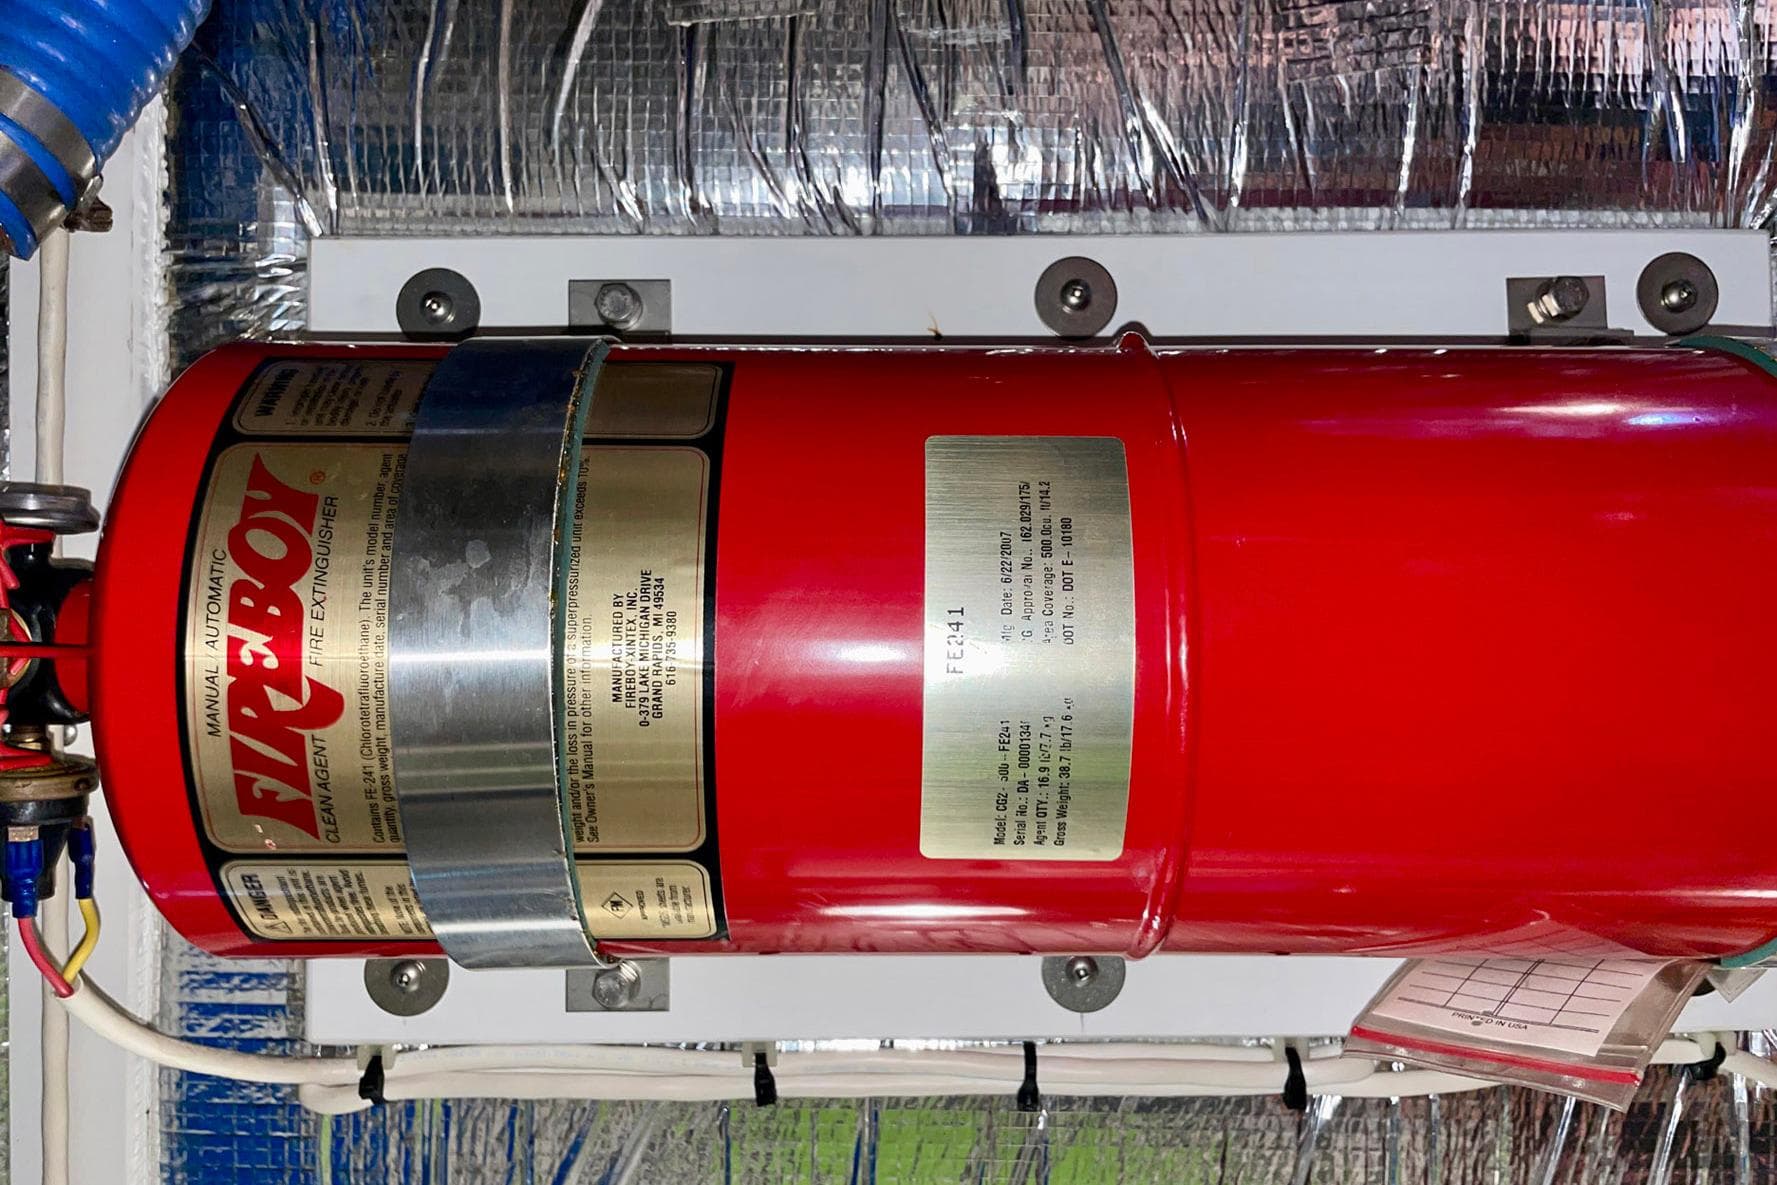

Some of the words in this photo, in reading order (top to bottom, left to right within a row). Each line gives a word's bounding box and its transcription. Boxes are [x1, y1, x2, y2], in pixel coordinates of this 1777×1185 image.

[255, 368, 299, 417] WARNING
[379, 453, 393, 479] agent
[387, 496, 398, 506] of
[573, 481, 587, 520] exceeds
[384, 507, 397, 530] area
[571, 523, 583, 542] unit
[365, 523, 379, 556] model
[380, 532, 393, 551] and
[311, 495, 338, 621] EXTINGUISHER
[1000, 531, 1012, 584] 6/22/2007
[362, 559, 375, 588] unit's
[377, 553, 390, 596] number
[640, 569, 652, 603] DRIVE
[1041, 562, 1056, 616] Coverage:
[1061, 570, 1074, 592] DOT
[205, 548, 226, 651] AUTOMATIC
[358, 591, 372, 611] The
[566, 545, 581, 640] superpressurized
[612, 593, 624, 608] BY
[626, 587, 638, 610] INC.
[653, 577, 665, 610] 49534
[1000, 588, 1013, 615] Date:
[1062, 596, 1074, 619] No.:
[374, 598, 386, 628] serial
[653, 613, 664, 627] MI
[226, 453, 344, 840] FIREBOY
[309, 626, 325, 667] FIRE
[579, 614, 593, 684] information.
[638, 606, 651, 662] MICHIGAN
[665, 611, 677, 686] 616-735-9380
[946, 607, 964, 674] FE241
[1062, 623, 1074, 644] DOT
[565, 653, 577, 664] of
[612, 611, 624, 703] MANUFACTURED
[625, 614, 638, 709] FIREBOY-XINTEX,
[358, 616, 376, 760] (Chlorotetrafluoroethane).
[566, 667, 579, 717] pressure
[638, 665, 650, 693] LAKE
[205, 665, 221, 737] MANUAL
[373, 661, 386, 730] manufacture
[579, 688, 593, 718] other
[651, 680, 664, 719] GRAND
[564, 719, 577, 730] in
[639, 696, 650, 727] 0-379
[565, 733, 578, 755] loss
[580, 721, 592, 737] for
[311, 734, 331, 792] AGENT
[566, 758, 579, 774] the
[580, 741, 594, 780] Manual
[1058, 755, 1072, 779] 38.7
[362, 765, 378, 800] FE-241
[380, 774, 395, 802] gross
[1038, 766, 1050, 788] 16.9
[566, 777, 582, 810] and/or
[581, 783, 598, 823] Owner's
[1015, 797, 1029, 817] No.:
[1036, 792, 1049, 818] QTY.:
[1055, 782, 1072, 819] Weight:
[317, 795, 341, 843] CLEAN
[368, 802, 386, 843] Contains
[570, 812, 586, 843] weight
[586, 825, 600, 843] See
[993, 814, 1008, 845] Model:
[1013, 820, 1026, 846] Serial
[1033, 821, 1048, 846] Agent
[1053, 821, 1067, 846] Gross
[240, 874, 278, 920] DANGER
[1508, 1022, 1528, 1030] USA
